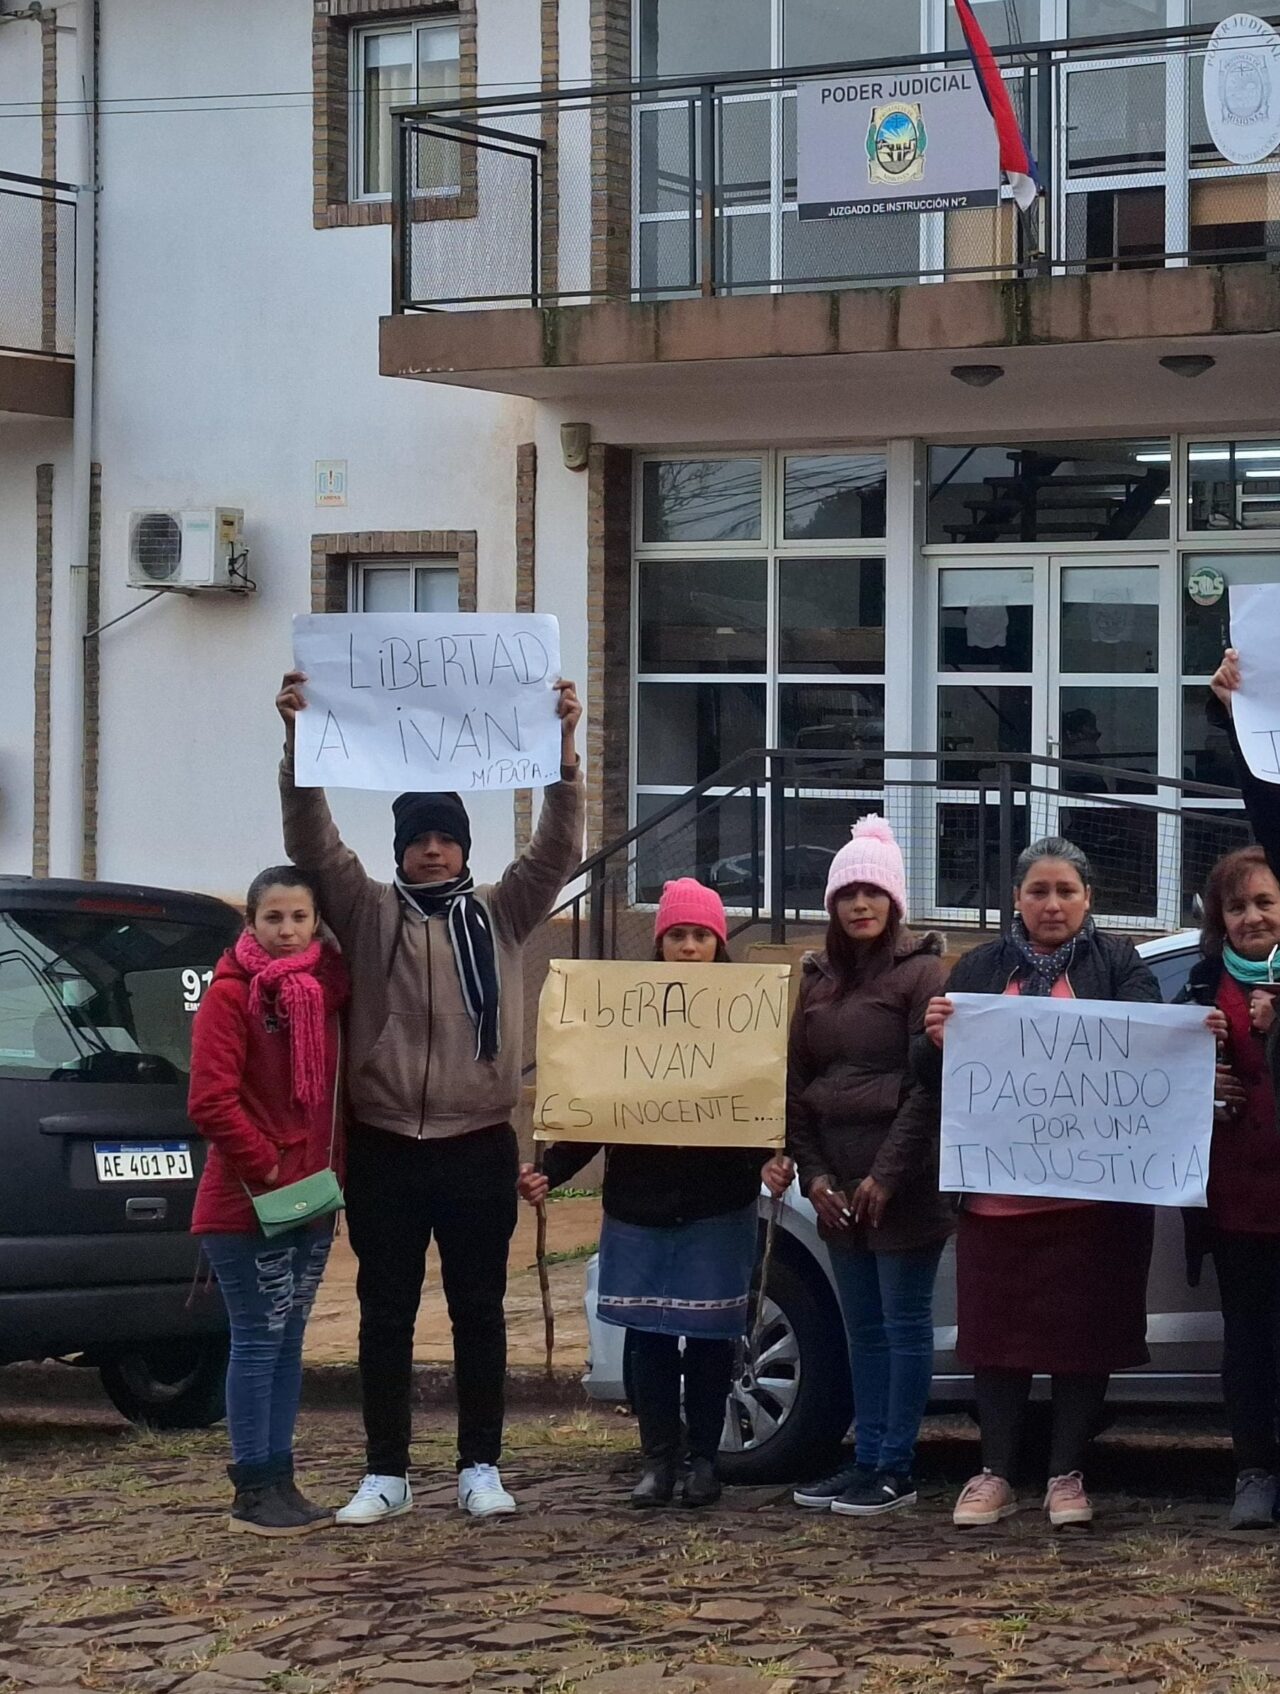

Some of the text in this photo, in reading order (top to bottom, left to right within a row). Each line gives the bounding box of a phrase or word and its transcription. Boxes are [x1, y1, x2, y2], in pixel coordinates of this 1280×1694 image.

[821, 74, 972, 104] PODER JUDICIAL
[828, 204, 871, 217] JUZGADO
[872, 203, 886, 214] DE
[886, 197, 950, 213] INSTRUCCIÓN
[316, 709, 349, 762] A
[1019, 1015, 1130, 1063] IVAN
[951, 1061, 1171, 1113] PAGANDO
[541, 1094, 594, 1130] ES
[1017, 1113, 1151, 1144] POR UNA
[103, 1154, 188, 1177] AE 401 PJ
